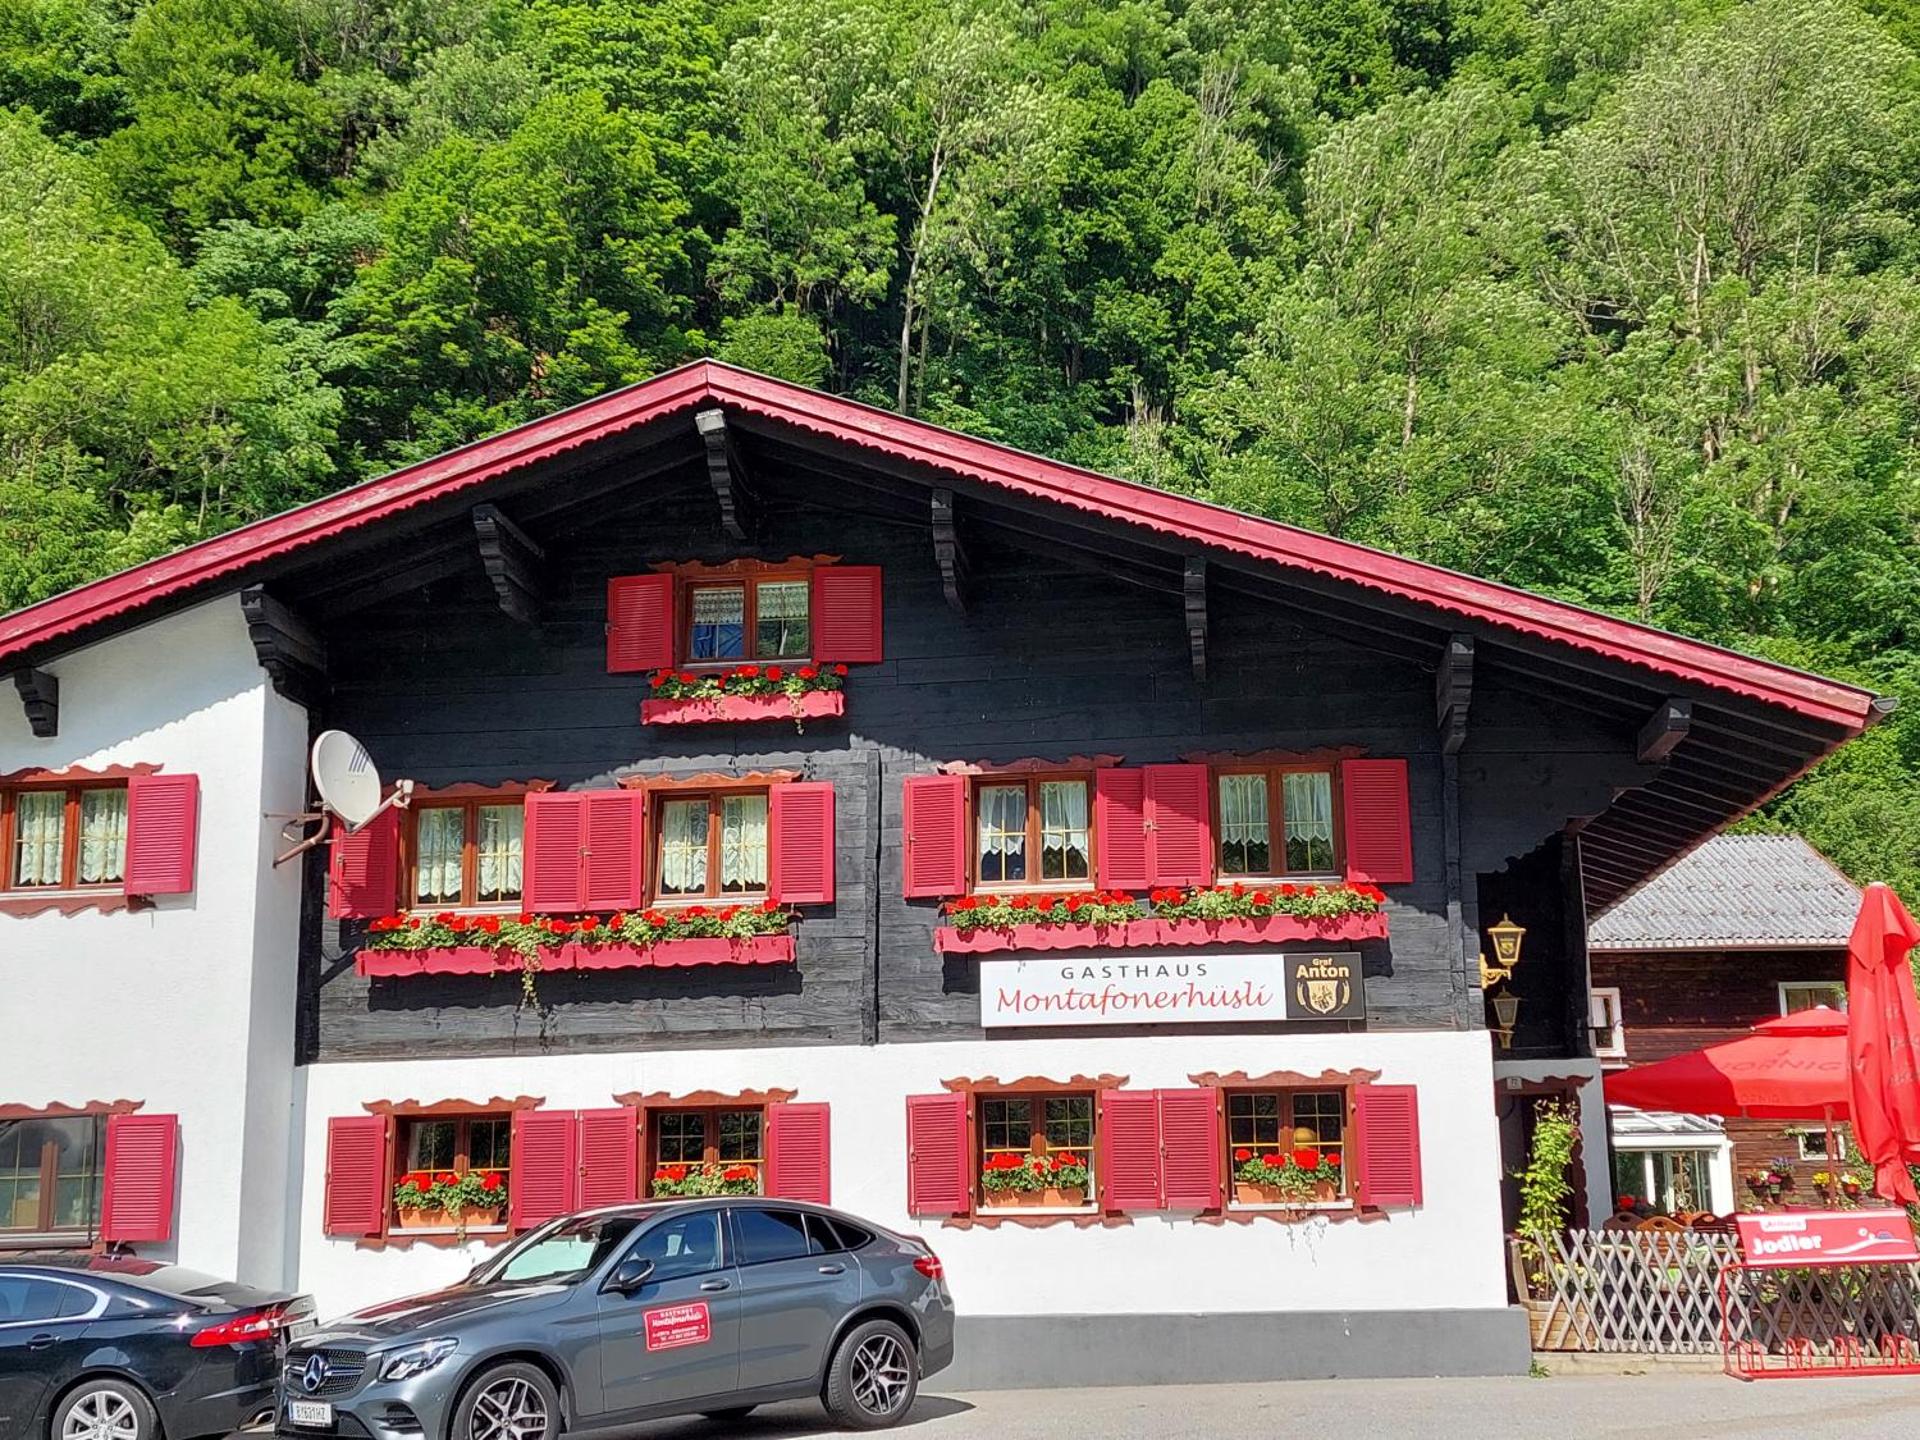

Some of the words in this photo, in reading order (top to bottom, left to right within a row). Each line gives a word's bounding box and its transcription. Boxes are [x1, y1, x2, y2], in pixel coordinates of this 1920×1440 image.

[1312, 957, 1333, 966] Graf
[1061, 963, 1207, 979] GASTHAUS
[1296, 964, 1350, 978] Anton
[996, 981, 1274, 1015] Montafonerhüsli
[1753, 1234, 1822, 1255] Jodler
